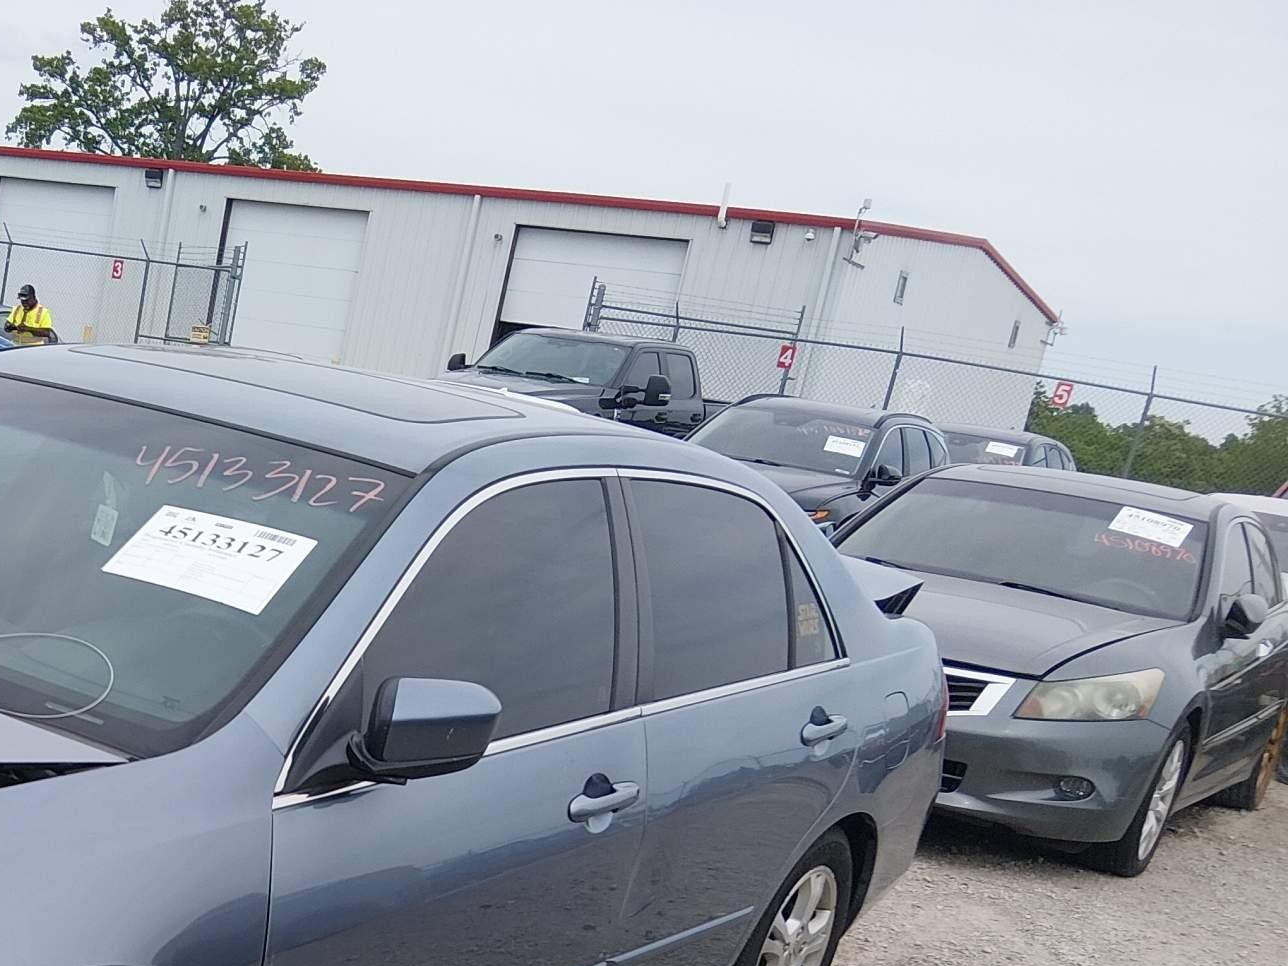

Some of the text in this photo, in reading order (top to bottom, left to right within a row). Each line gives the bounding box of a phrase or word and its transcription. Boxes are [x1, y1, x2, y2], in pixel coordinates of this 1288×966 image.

[113, 261, 122, 278] 3
[778, 348, 793, 367] 4
[1053, 384, 1072, 404] 5
[135, 445, 385, 513] 45133127
[159, 524, 284, 563] 45133127
